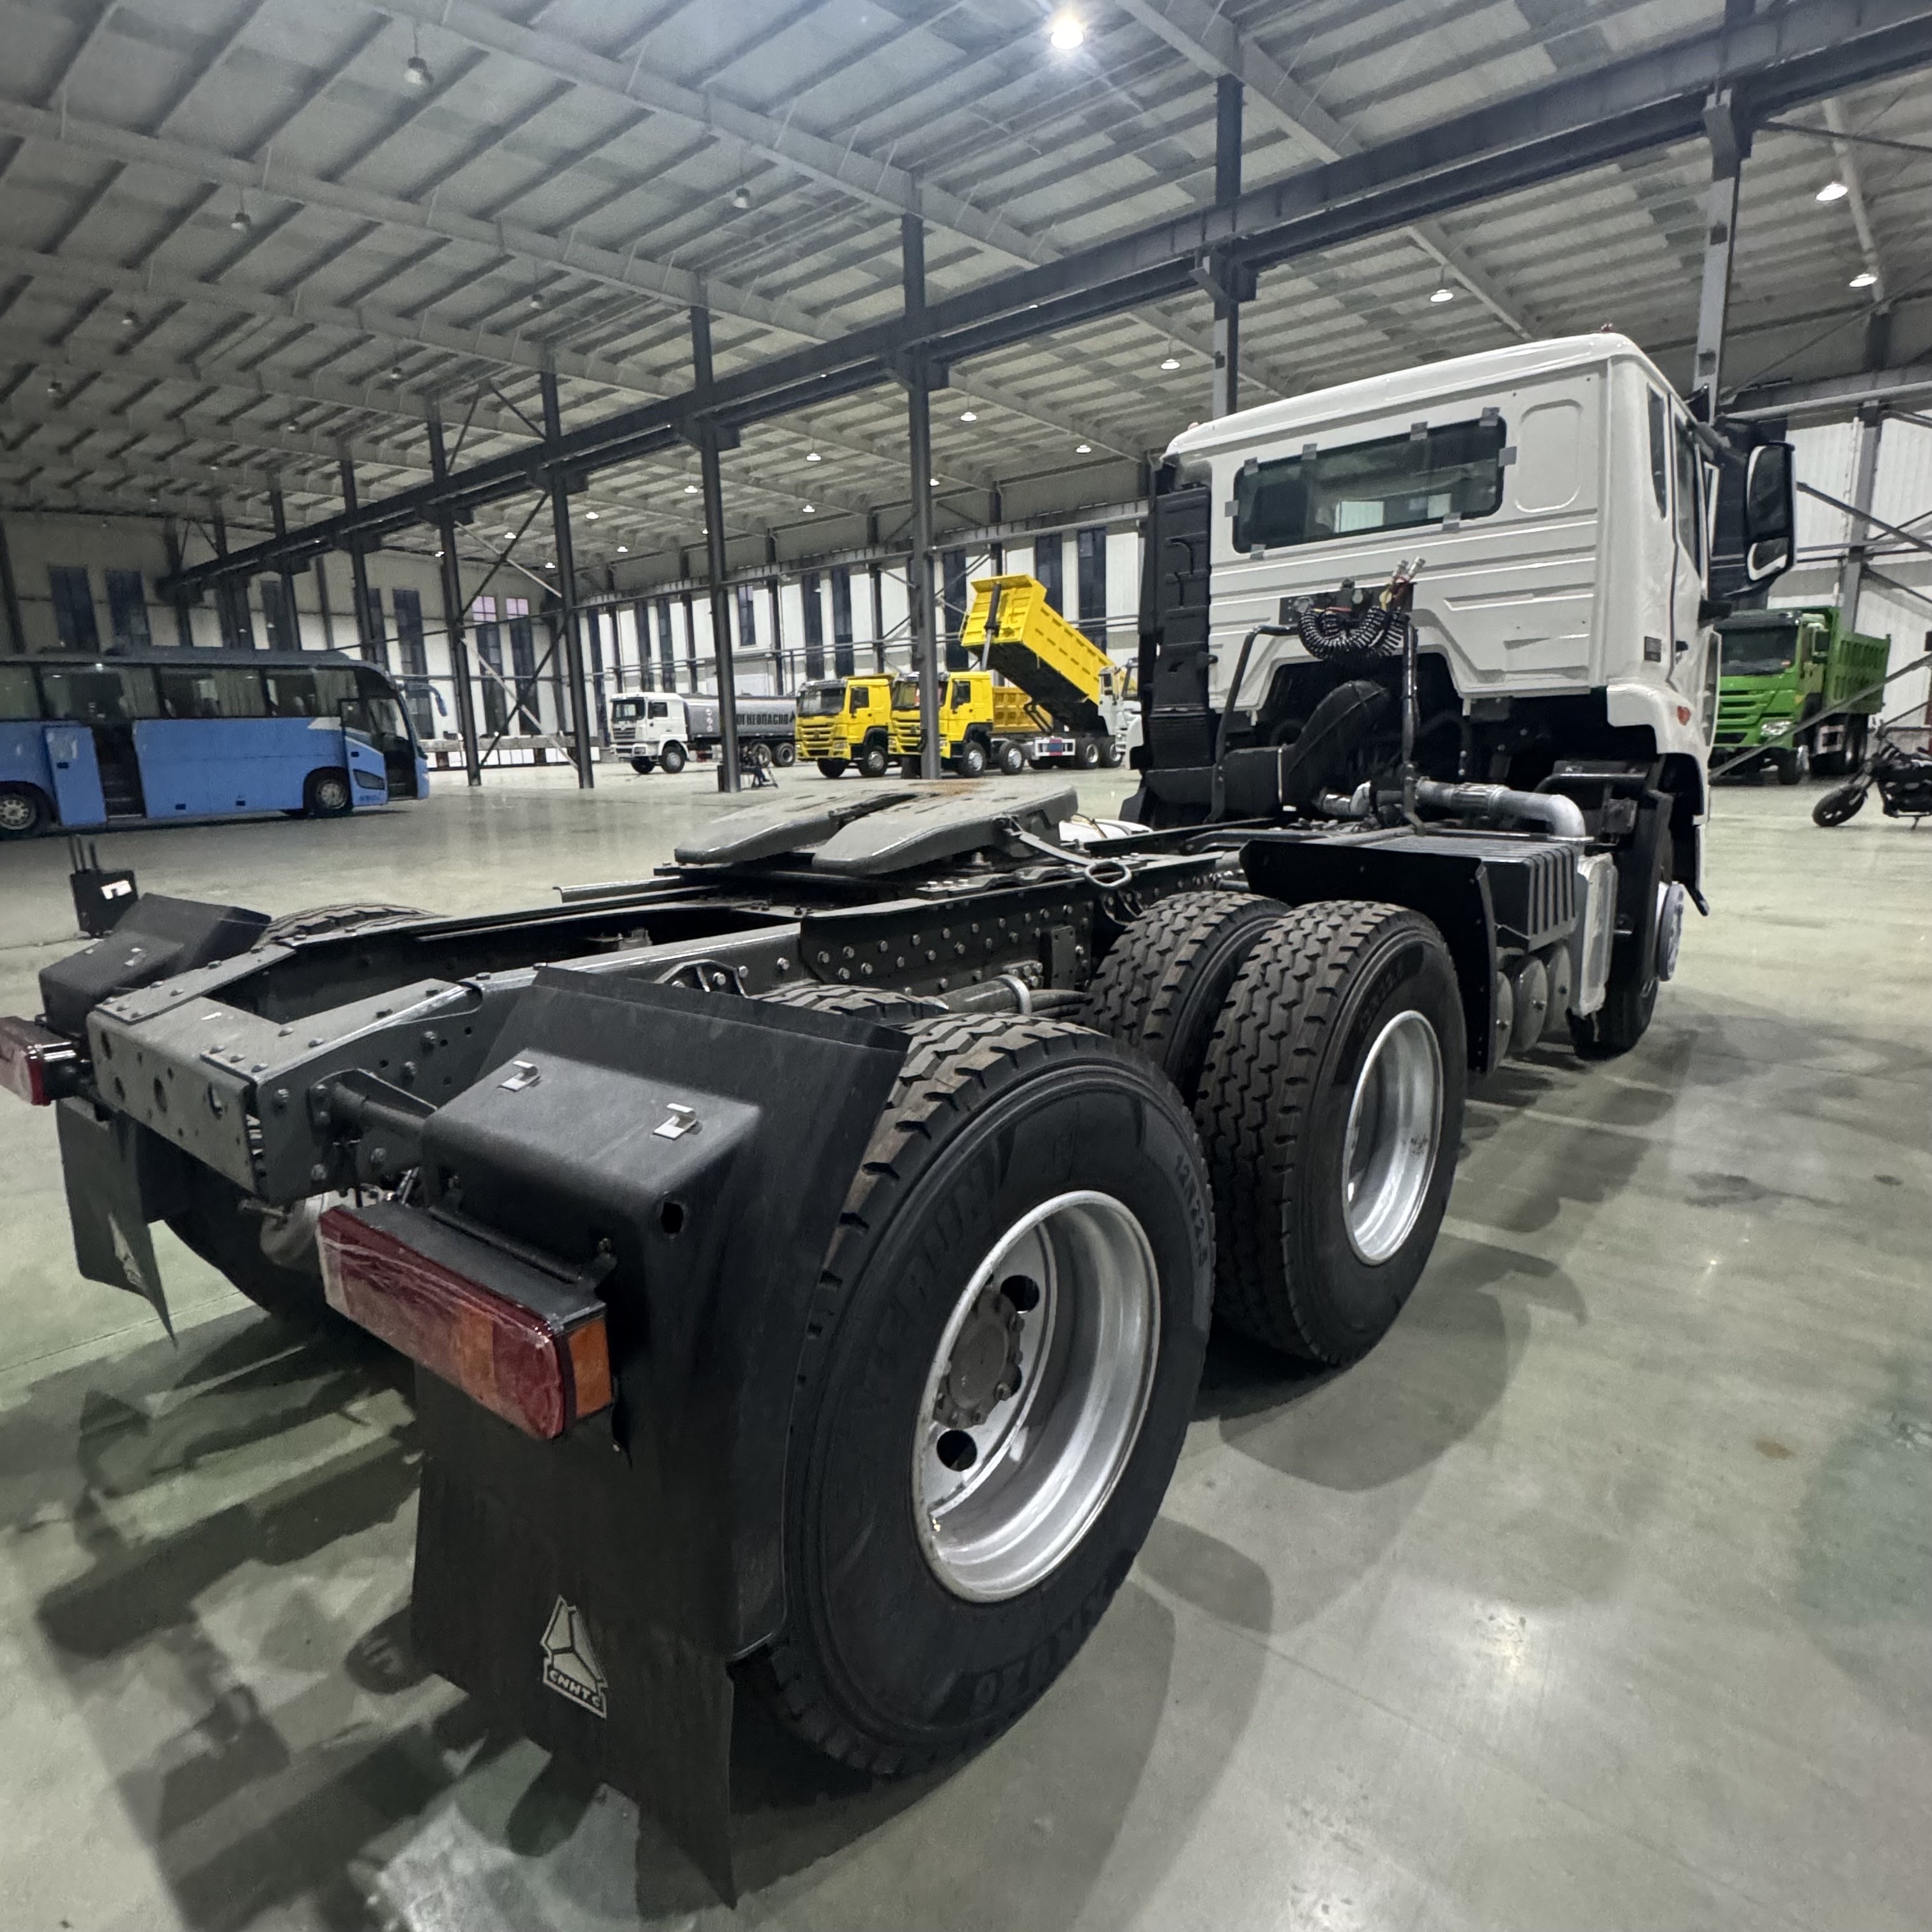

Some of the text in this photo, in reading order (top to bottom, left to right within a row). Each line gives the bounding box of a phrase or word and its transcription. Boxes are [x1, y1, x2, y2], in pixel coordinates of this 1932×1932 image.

[737, 714, 788, 725] ОГНЕОПАСНО
[1175, 1153, 1208, 1268] 12R22.5
[549, 1669, 601, 1707] CNHTC
